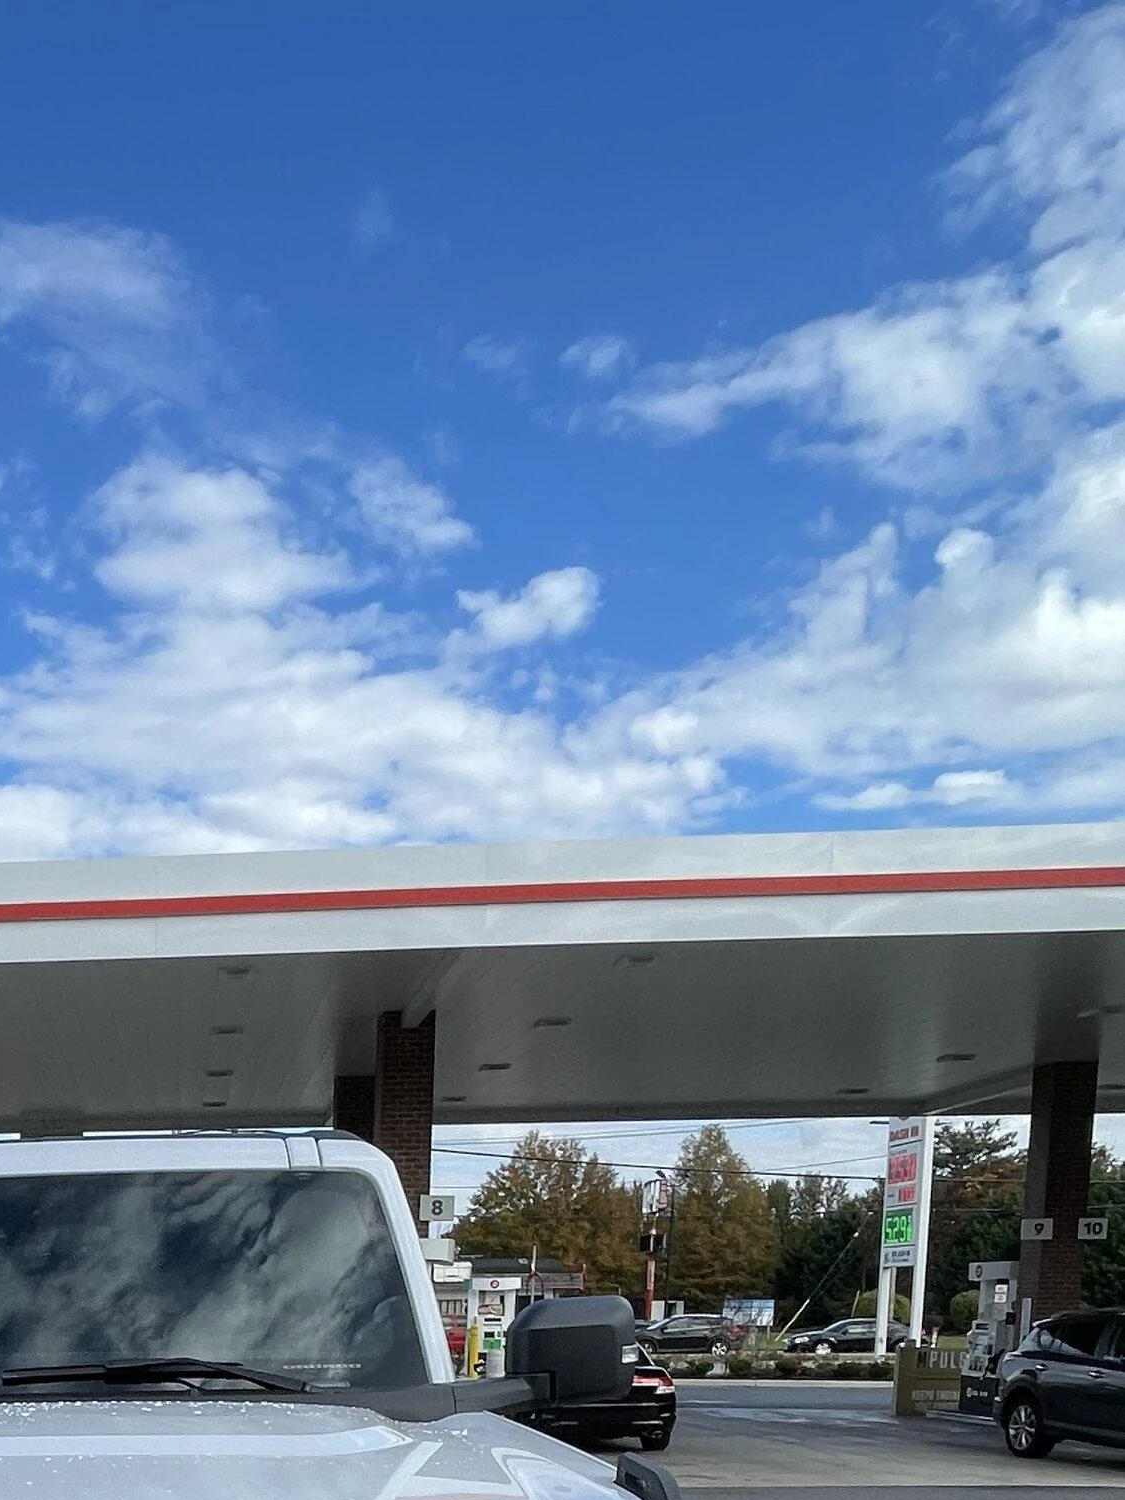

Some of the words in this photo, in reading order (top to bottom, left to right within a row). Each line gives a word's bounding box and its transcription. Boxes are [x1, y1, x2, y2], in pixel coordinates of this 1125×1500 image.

[431, 1199, 444, 1216] 8
[1034, 1222, 1045, 1236] 9
[1084, 1222, 1103, 1236] 10
